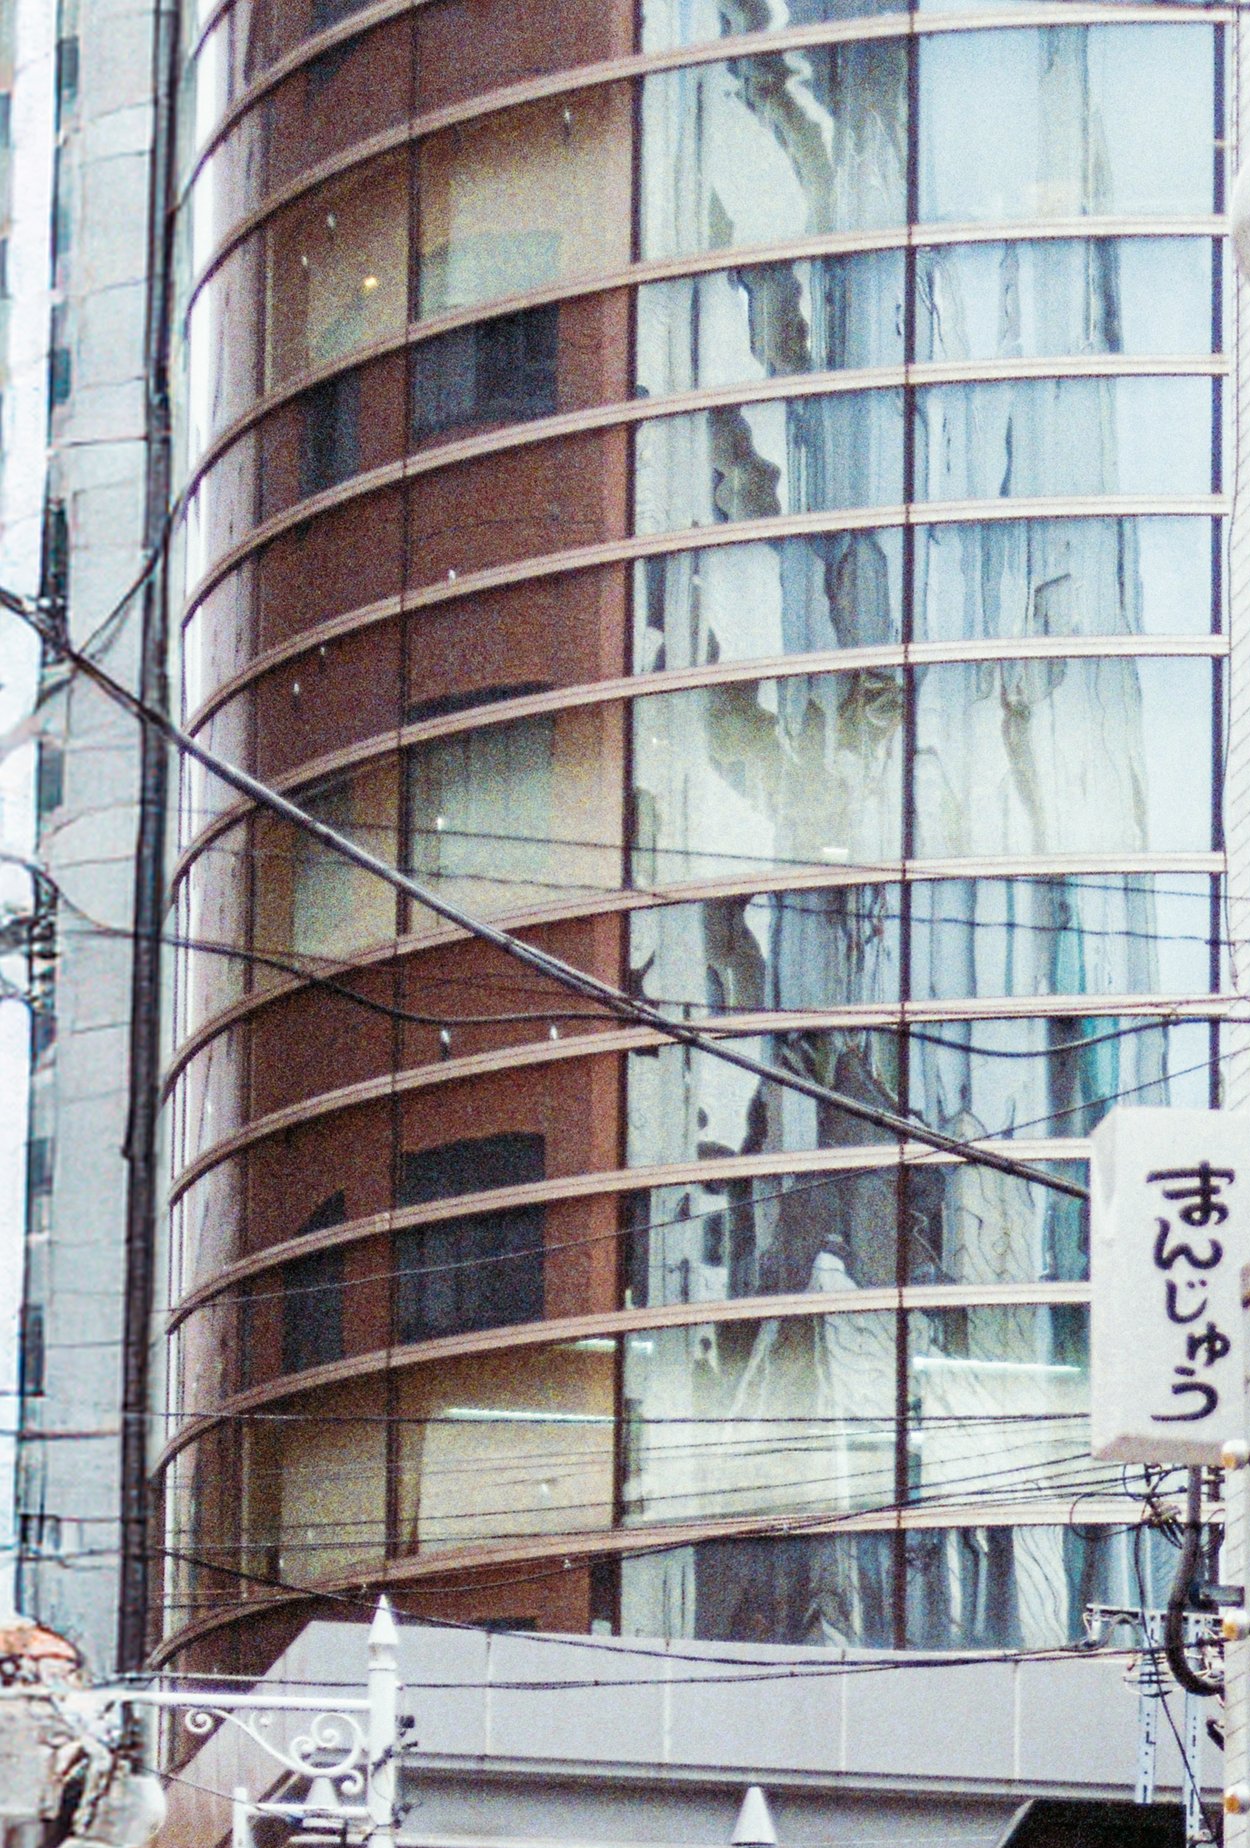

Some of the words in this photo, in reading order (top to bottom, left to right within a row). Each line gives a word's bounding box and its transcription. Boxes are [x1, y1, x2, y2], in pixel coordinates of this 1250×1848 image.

[1146, 1160, 1236, 1422] まんじゅう
